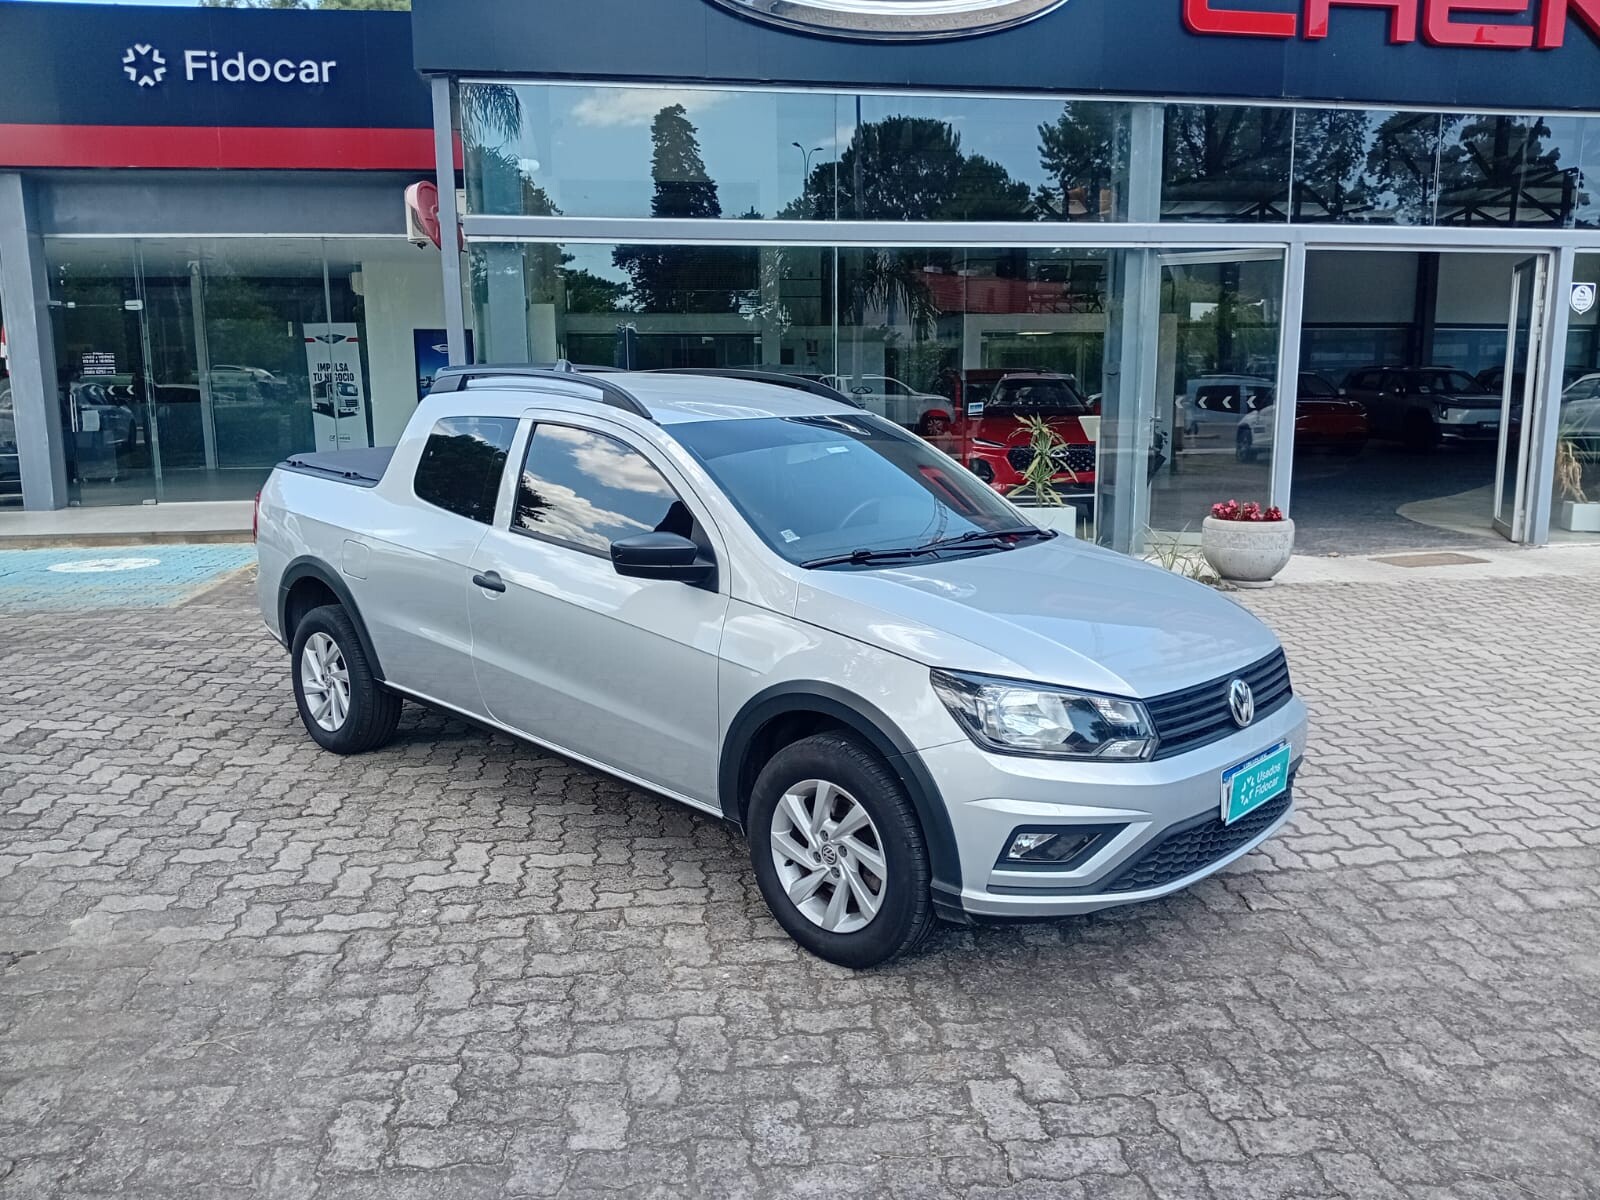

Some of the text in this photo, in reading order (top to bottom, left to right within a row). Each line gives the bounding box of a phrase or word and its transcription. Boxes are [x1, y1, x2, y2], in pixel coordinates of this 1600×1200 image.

[184, 50, 337, 83] Fidocar
[313, 372, 323, 382] TU
[317, 362, 349, 372] IMPLSA
[1256, 763, 1281, 783] Usados
[1254, 776, 1279, 798] Fidocar
